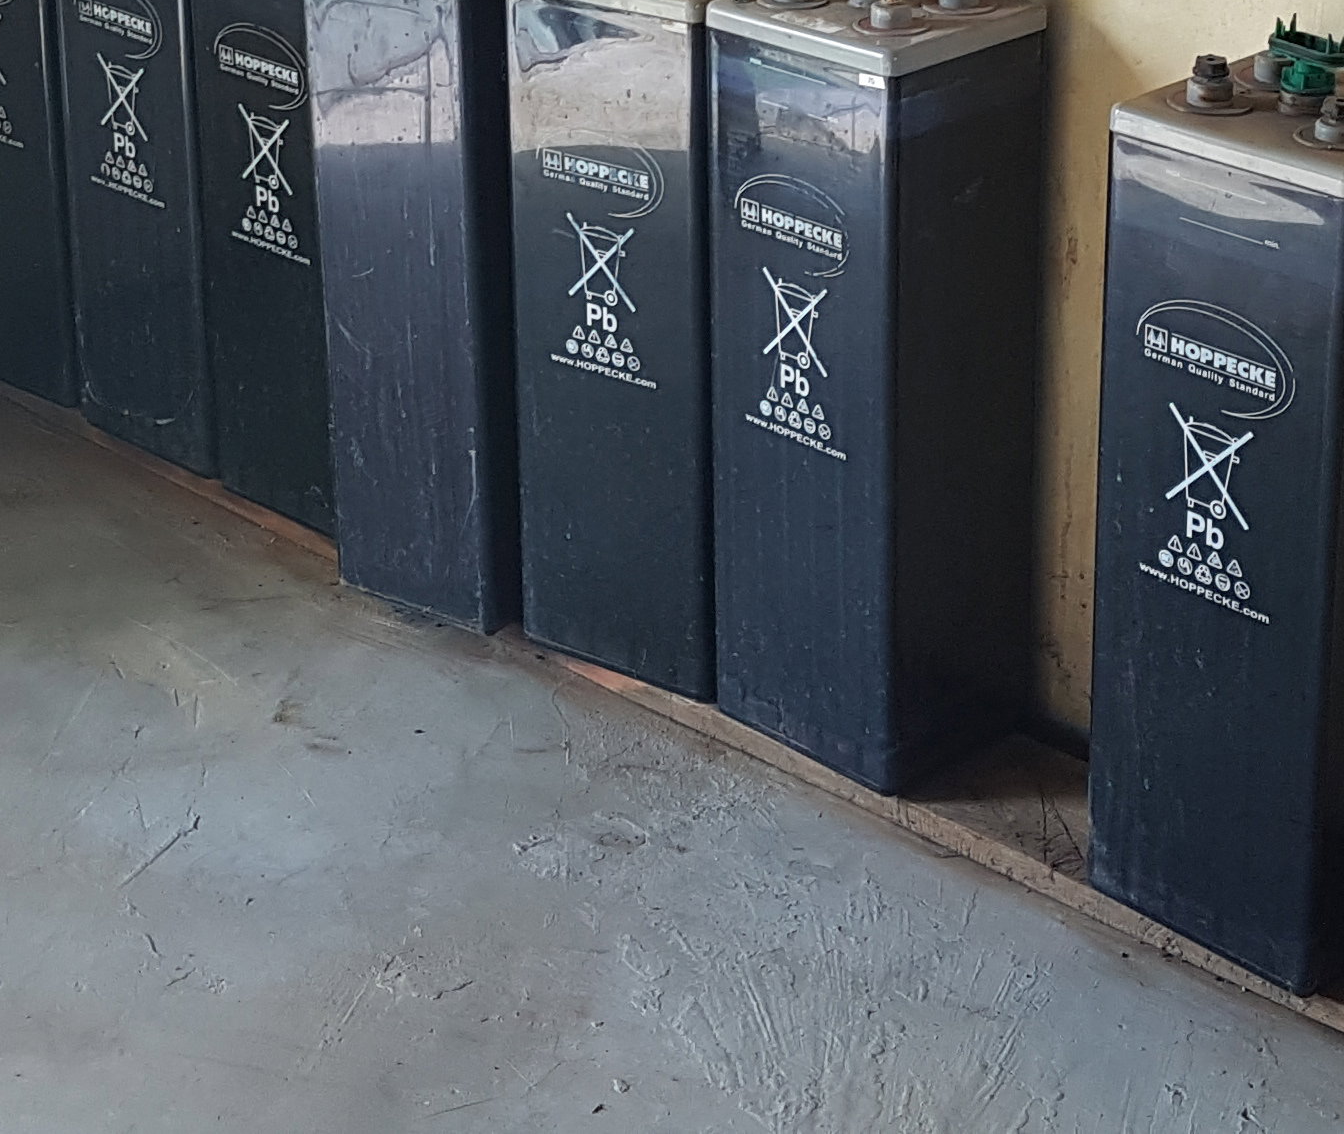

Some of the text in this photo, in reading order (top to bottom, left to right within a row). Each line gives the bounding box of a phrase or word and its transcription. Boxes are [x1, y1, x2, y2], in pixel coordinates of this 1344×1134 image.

[93, 4, 152, 35] HOPPECKE
[234, 53, 298, 84] HOPPECKE
[113, 132, 136, 158] Pb
[564, 156, 649, 189] HOPPECKE
[579, 177, 608, 193] Quality
[256, 185, 279, 213] Pb
[761, 208, 842, 248] HOPPECKE
[587, 302, 618, 332] Pb
[550, 353, 657, 389] www.HOPPECKE.com
[1144, 348, 1276, 402] German Quality Standard
[1170, 336, 1276, 388] HOPPECKE
[780, 363, 810, 397] Pb
[745, 413, 847, 461] www.HOPPECKE.com
[1186, 510, 1224, 550] Pb
[1139, 562, 1270, 625] www.HOPPECKE.com
